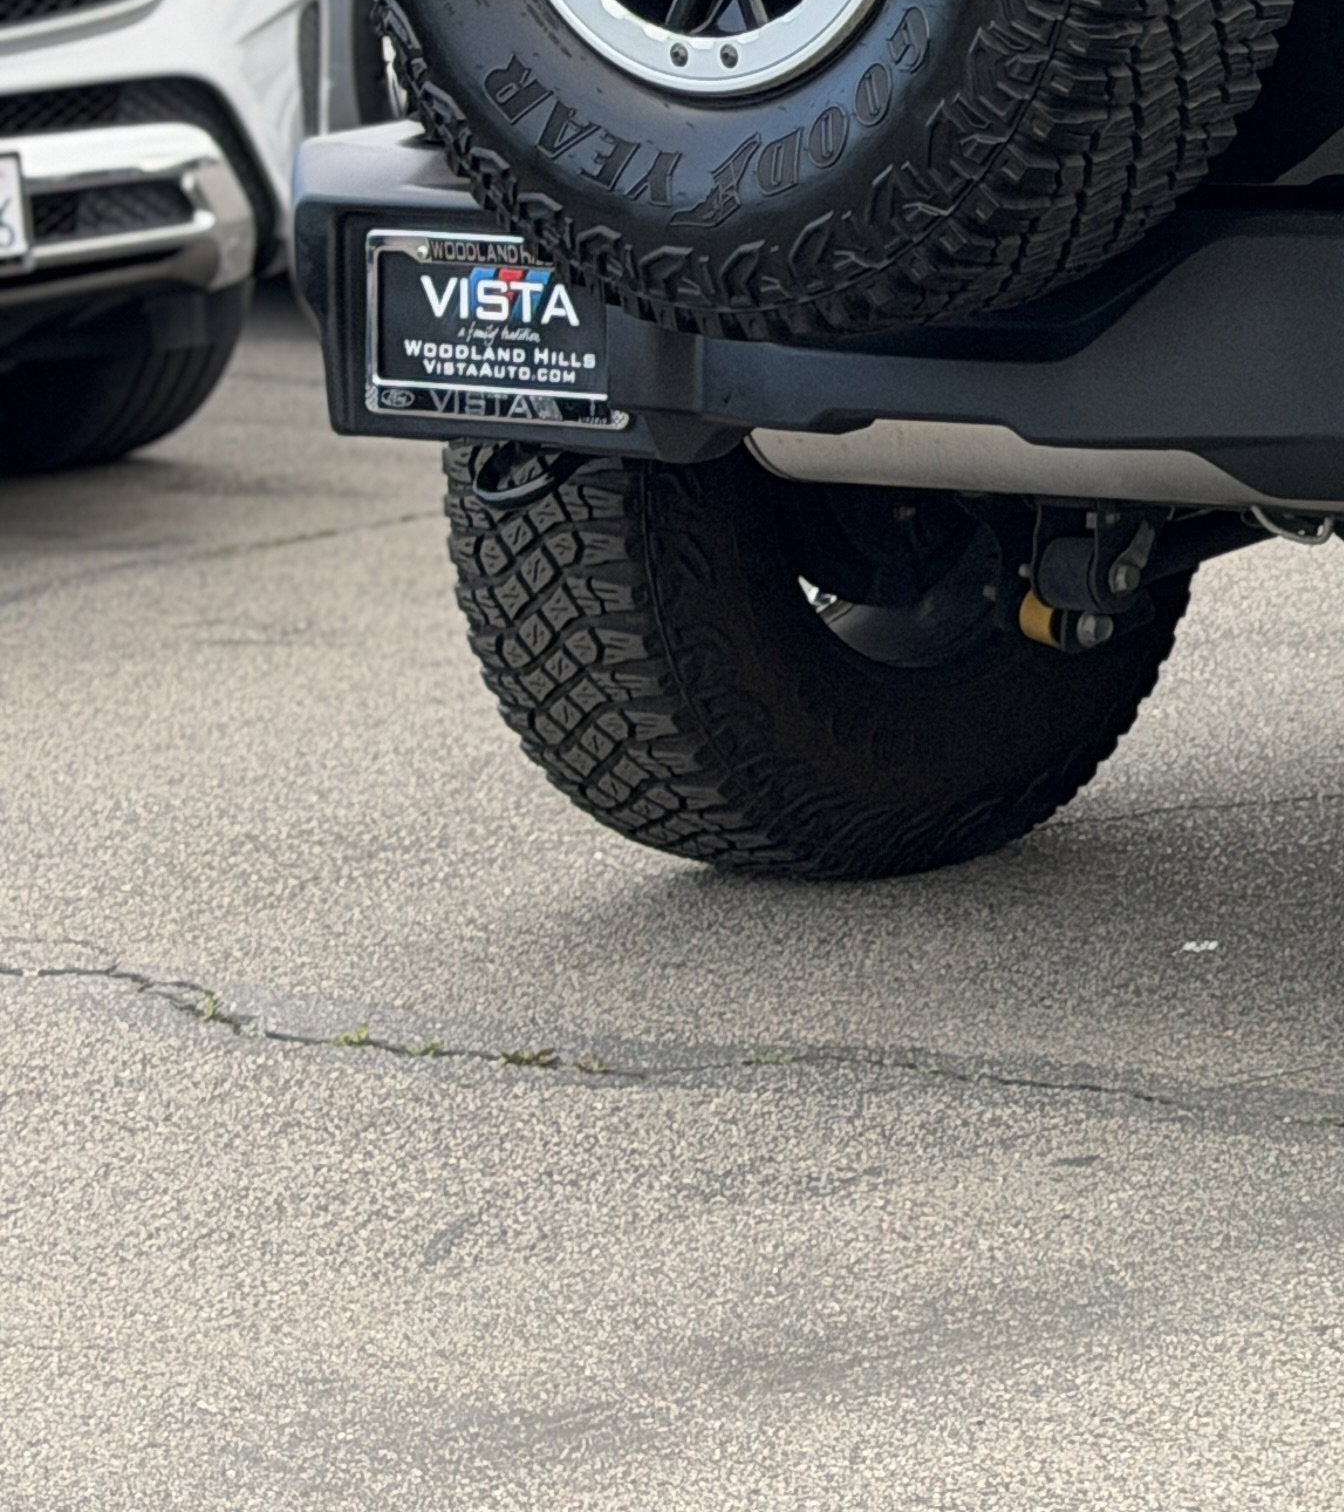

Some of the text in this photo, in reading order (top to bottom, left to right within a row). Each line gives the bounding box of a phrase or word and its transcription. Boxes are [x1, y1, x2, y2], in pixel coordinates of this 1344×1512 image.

[431, 241, 519, 265] WOODLAND
[419, 274, 580, 328] VISTA
[404, 338, 597, 369] WOODLAND HILLS
[429, 388, 533, 421] VISTA
